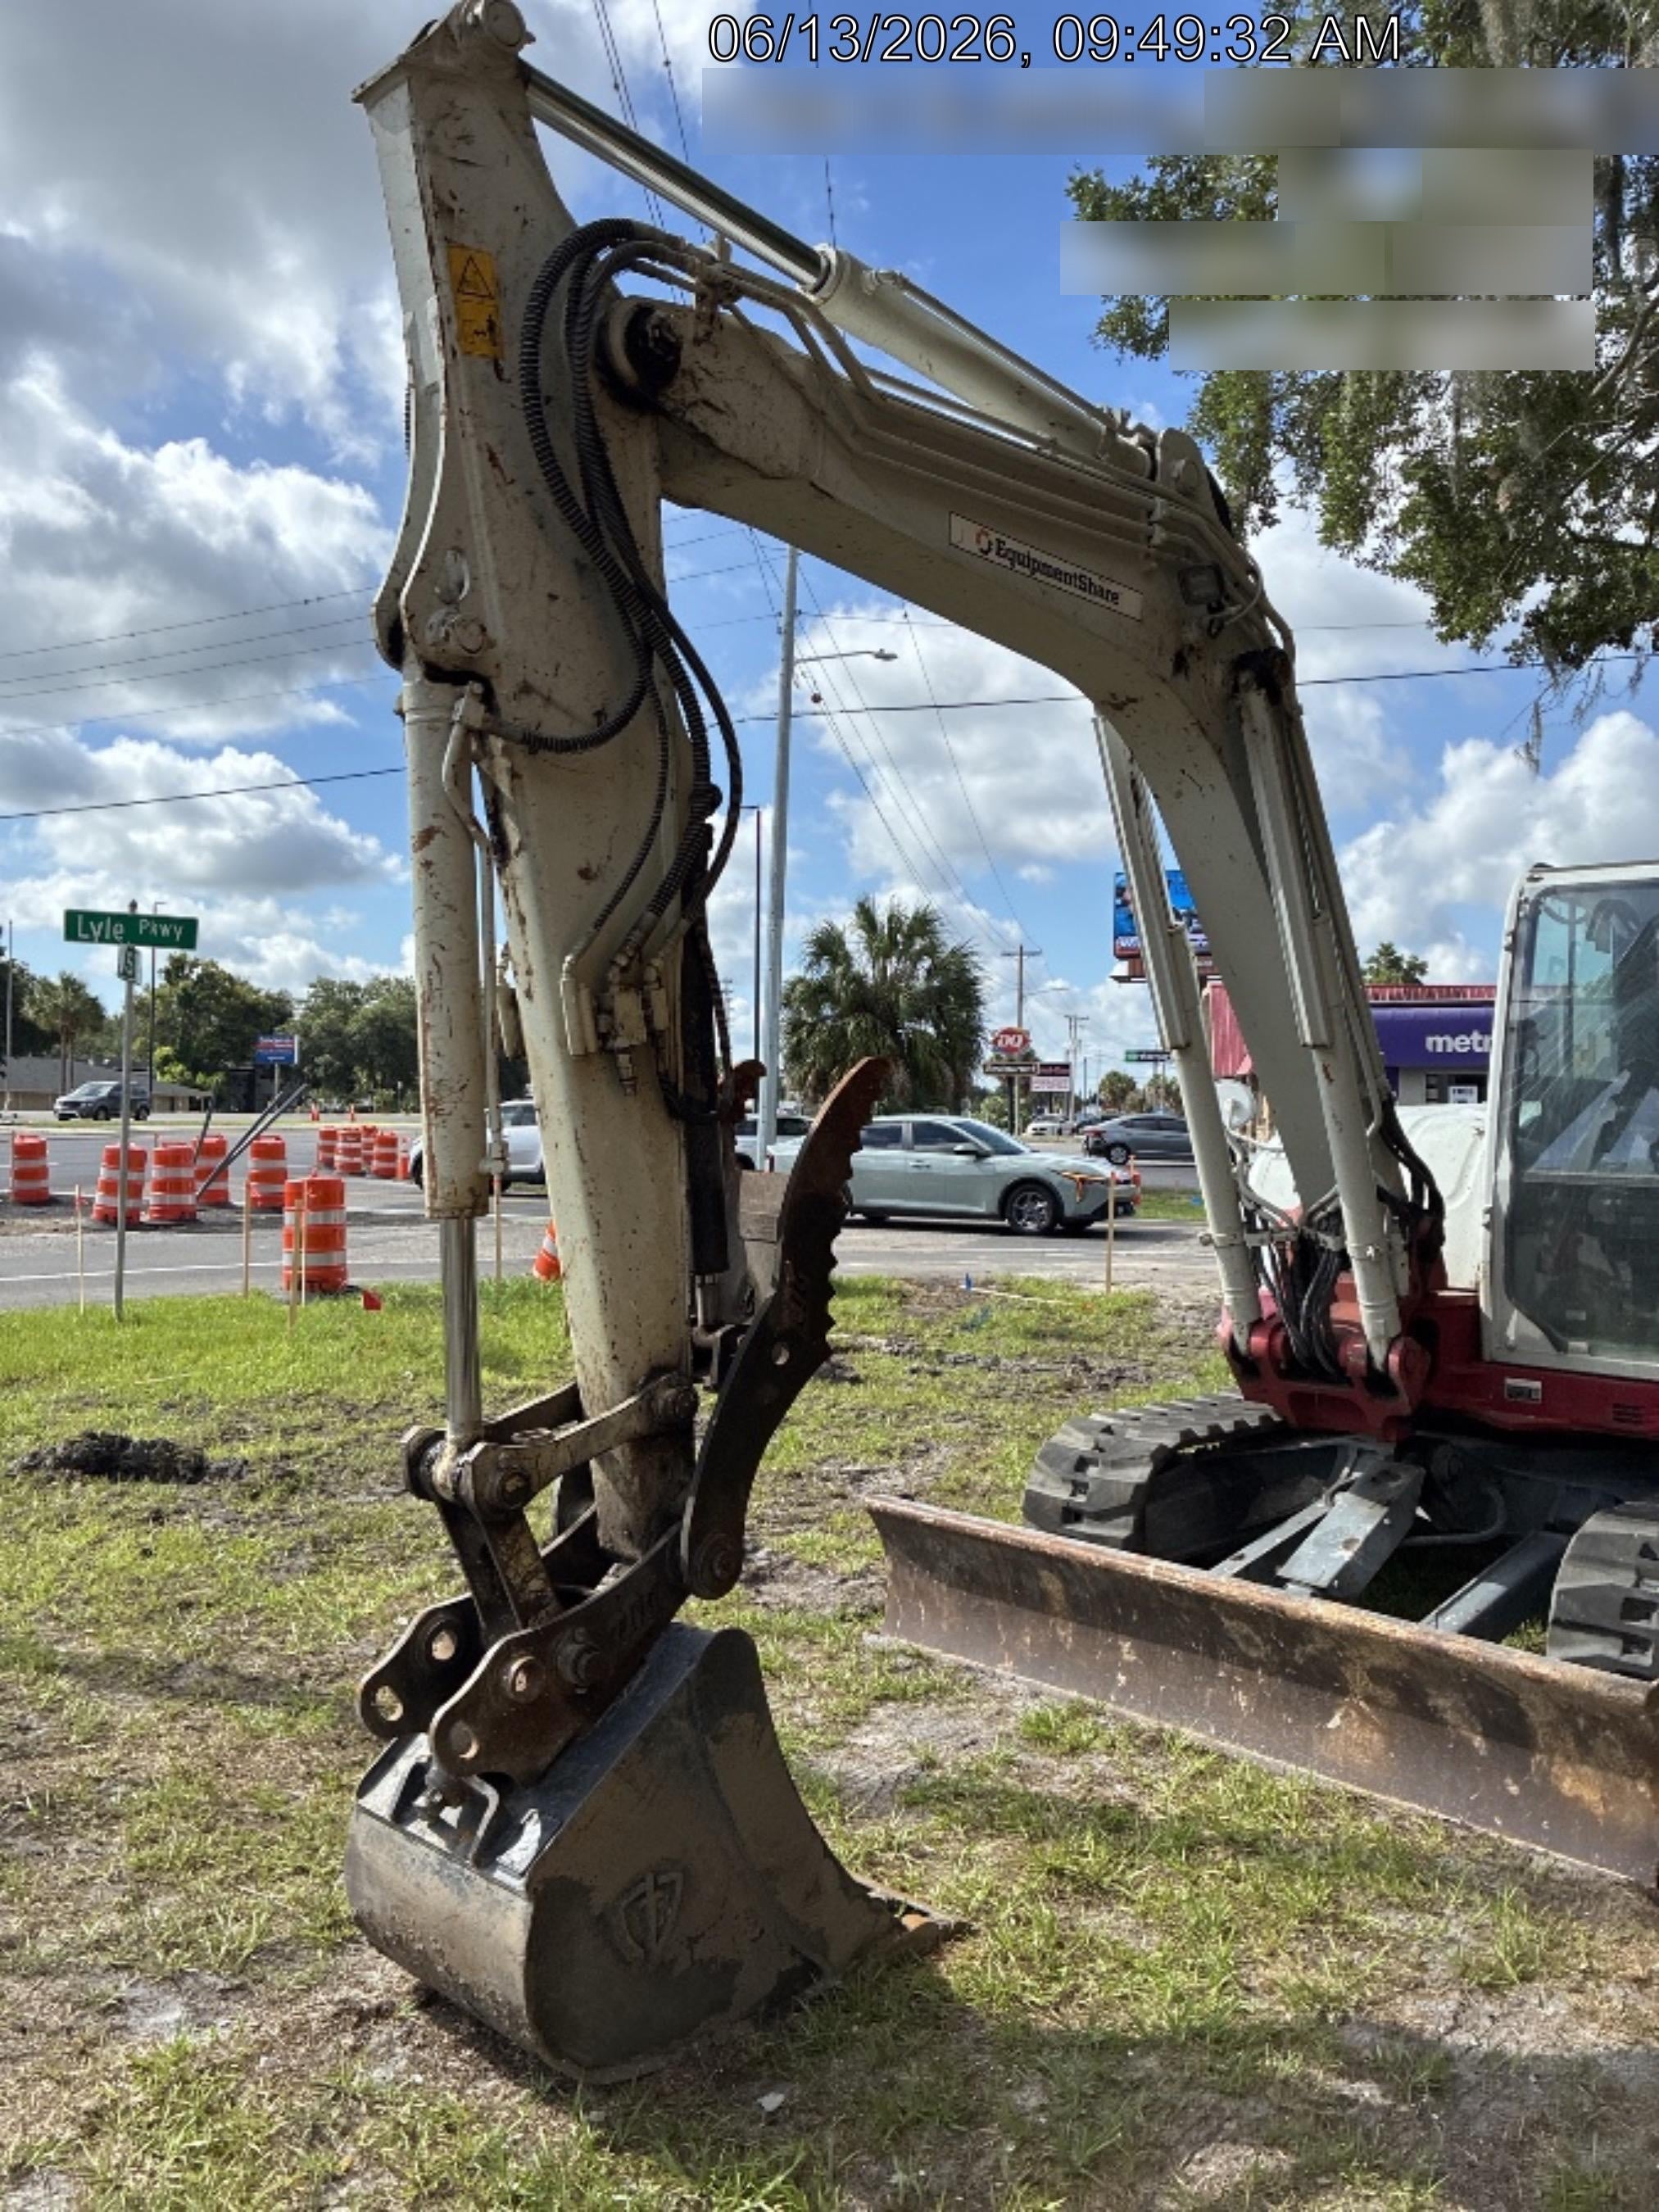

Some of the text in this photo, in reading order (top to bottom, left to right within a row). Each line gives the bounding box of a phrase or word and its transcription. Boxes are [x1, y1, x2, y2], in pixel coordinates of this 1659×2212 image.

[995, 537, 1120, 605] EquipmentShare
[77, 914, 184, 943] Lyle Pkwy
